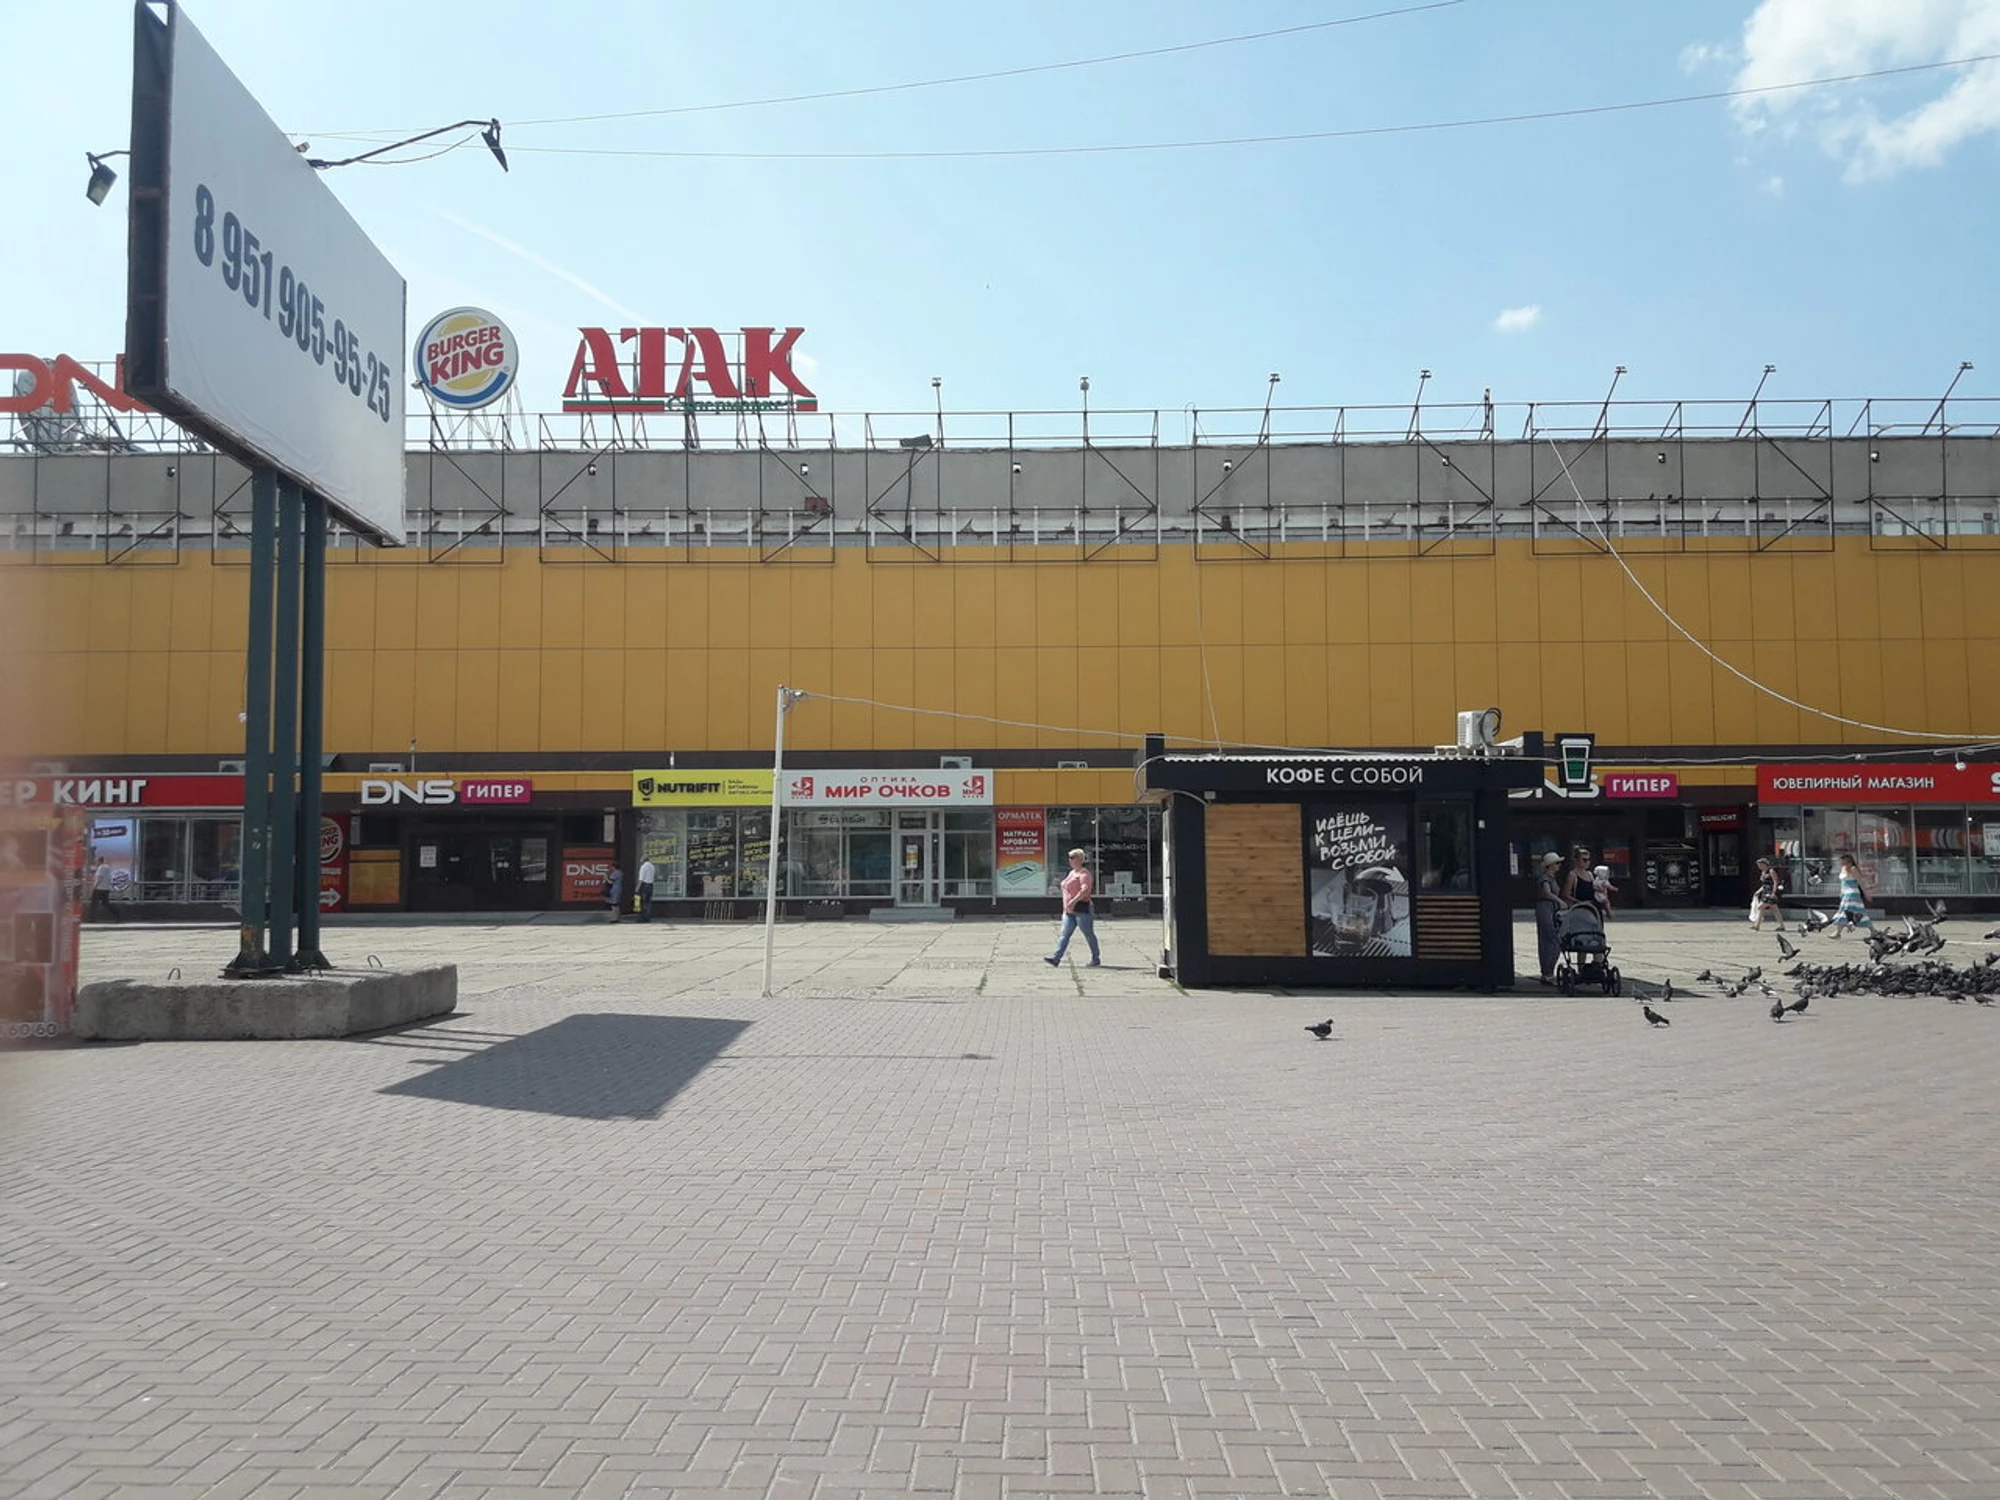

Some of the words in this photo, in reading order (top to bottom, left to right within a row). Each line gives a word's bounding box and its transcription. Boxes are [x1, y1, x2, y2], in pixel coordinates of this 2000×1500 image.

[194, 184, 215, 267] 8
[222, 211, 273, 321] 951
[278, 265, 391, 423] 905-95-25
[427, 325, 501, 362] BURGER
[430, 342, 504, 385] KING
[562, 327, 816, 398] АТАК
[1267, 767, 1325, 783] КОФЕ
[1331, 767, 1345, 783] С
[1350, 766, 1423, 783] СОБОЙ
[1773, 775, 1862, 789] ЮВЕЛИРНЫЙ
[1868, 777, 1934, 789] МАГАЗИН
[53, 780, 147, 803] КИНГ
[361, 780, 455, 804] DNS
[467, 785, 525, 798] ГИПЕР
[658, 783, 721, 793] NUTRIFIT
[825, 785, 872, 798] МИР
[878, 785, 951, 798] ОЧКОВ
[1612, 779, 1670, 792] ГИПЕР
[1315, 812, 1370, 833] ИДЁШЬ
[1314, 832, 1325, 846] К
[1320, 834, 1386, 860] ВОЗЬМИ
[1332, 858, 1345, 870] С
[1345, 844, 1396, 867] СОБОЙ
[566, 864, 609, 876] DNS
